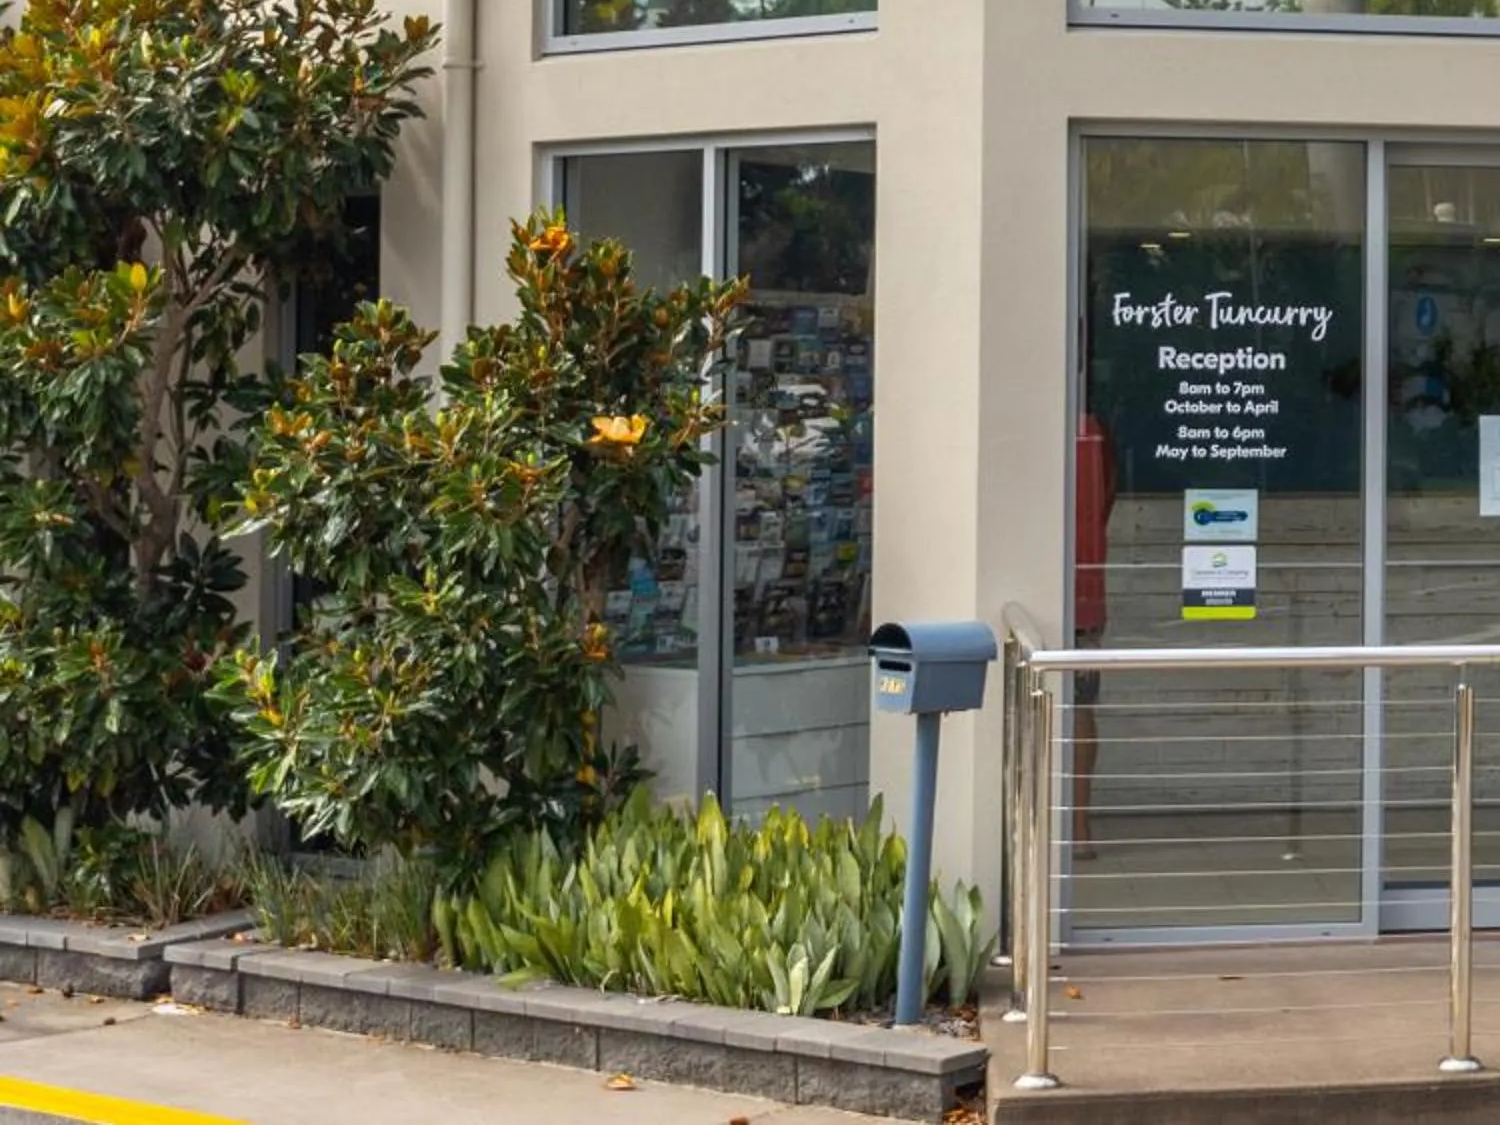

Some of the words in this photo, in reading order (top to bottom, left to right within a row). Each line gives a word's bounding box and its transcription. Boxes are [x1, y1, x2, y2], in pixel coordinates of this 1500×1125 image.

[1112, 291, 1199, 328] Forster
[1204, 291, 1333, 341] Tuncurry
[1158, 346, 1286, 374] Reception
[1179, 381, 1212, 395] 8am
[1215, 381, 1230, 395] to
[1233, 381, 1265, 398] 7pm
[1164, 399, 1223, 414] October
[1226, 400, 1241, 414] to
[1243, 400, 1279, 417] April
[1178, 425, 1211, 439] 8am
[1213, 426, 1229, 439] to
[1232, 426, 1265, 442] 6pm
[1155, 444, 1188, 461] May
[1191, 444, 1207, 458] to
[1210, 444, 1287, 461] September
